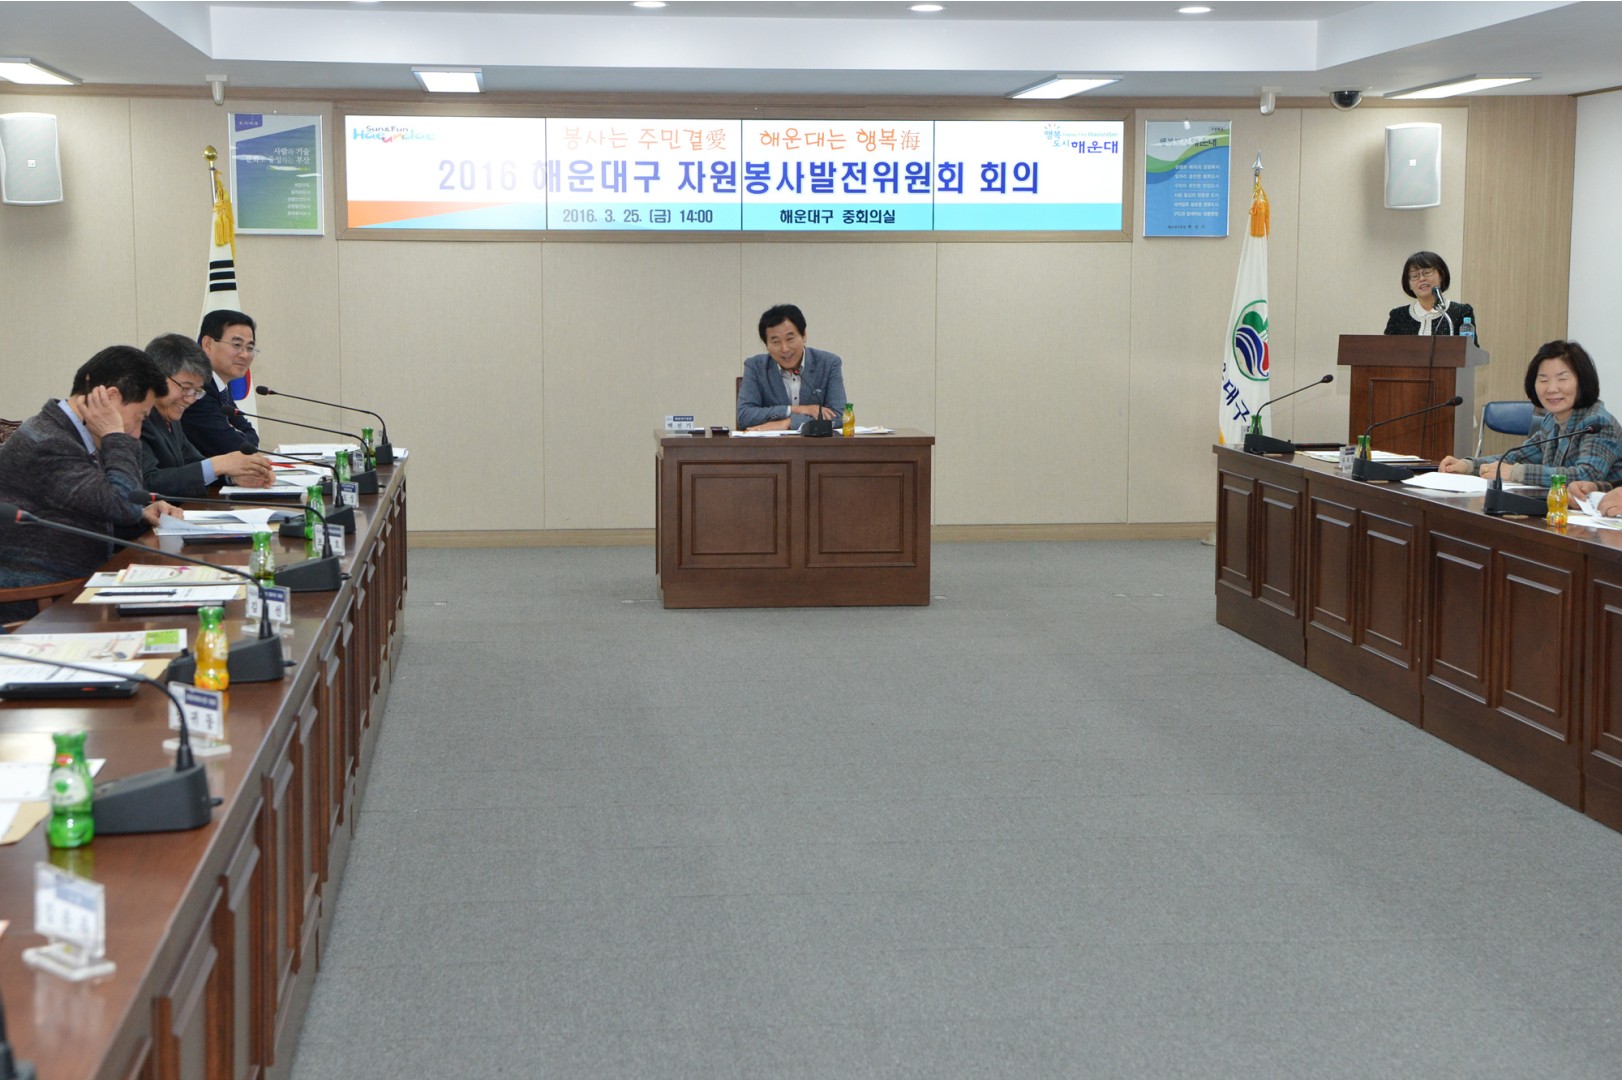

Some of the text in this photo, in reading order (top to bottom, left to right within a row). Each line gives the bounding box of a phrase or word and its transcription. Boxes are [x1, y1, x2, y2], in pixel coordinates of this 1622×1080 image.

[562, 126, 629, 150] 봉사는
[759, 127, 921, 152] 해운대는 행복海
[1071, 140, 1119, 154] 해운대
[438, 159, 1039, 195] 2016 해운대구 자원봉사발전위원회 회의
[562, 209, 713, 224] 2016. 3. 25. (금) 14:00
[779, 209, 896, 224] 해운대구 중회의실
